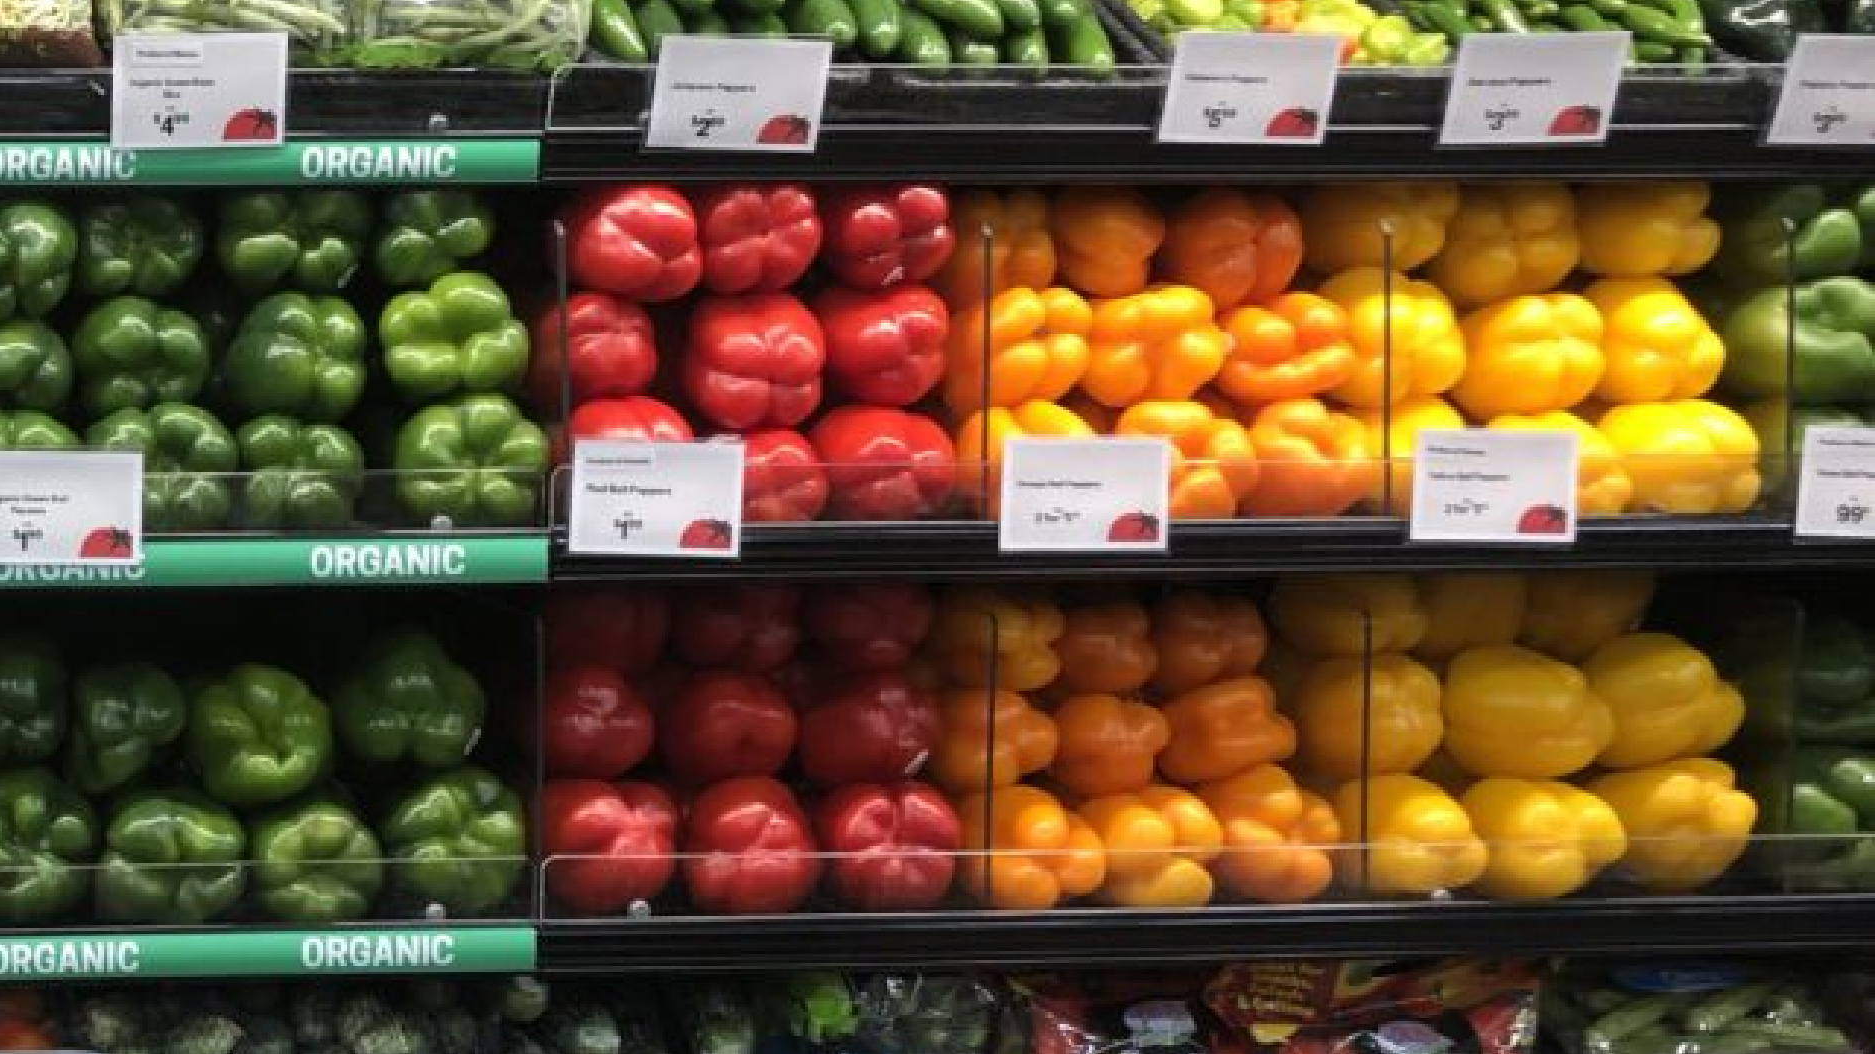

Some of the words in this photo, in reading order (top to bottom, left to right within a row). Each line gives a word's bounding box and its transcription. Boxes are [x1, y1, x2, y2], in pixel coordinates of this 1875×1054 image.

[300, 144, 455, 178] ORGANIC
[311, 543, 465, 577] ORGANIC
[301, 932, 455, 967] ORGANIC
